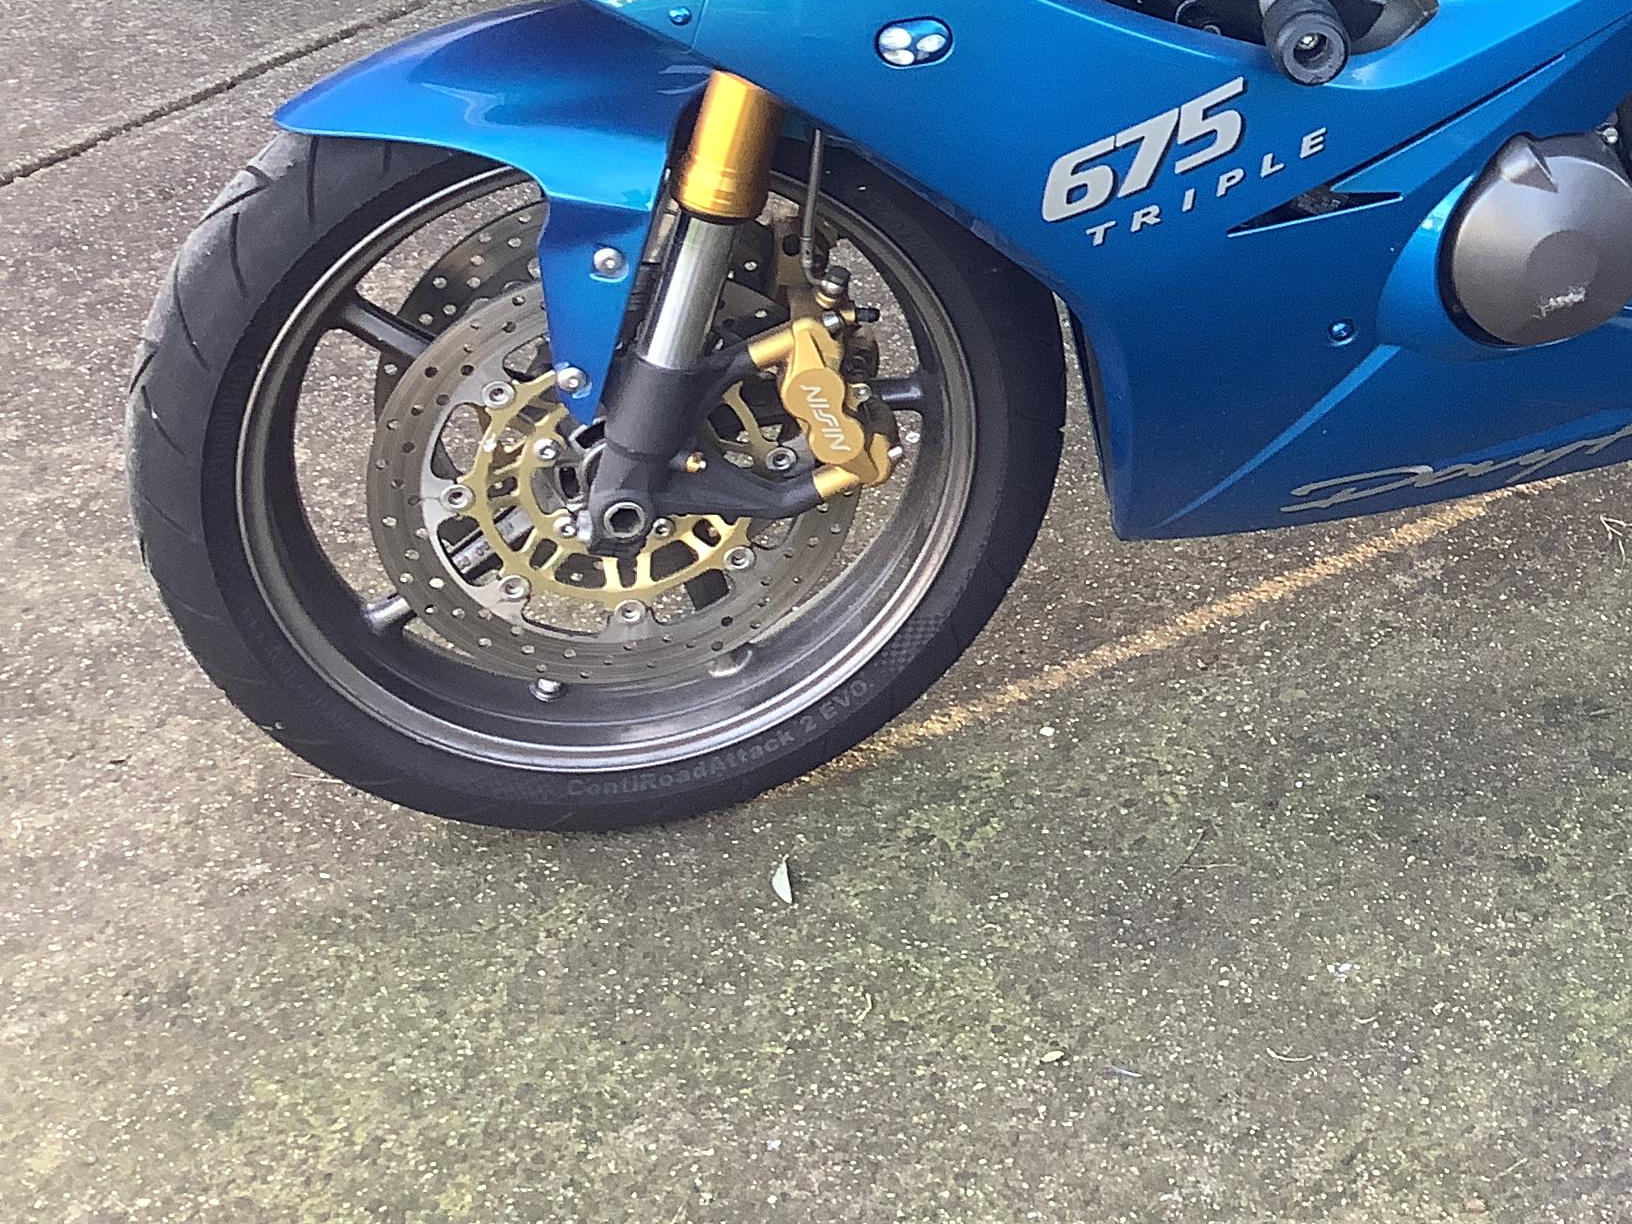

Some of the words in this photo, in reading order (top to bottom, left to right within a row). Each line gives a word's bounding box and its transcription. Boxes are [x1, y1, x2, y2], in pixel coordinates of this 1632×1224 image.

[1041, 75, 1247, 223] 675
[1085, 127, 1327, 246] TRIPLE
[802, 384, 851, 452] NISSIN
[799, 713, 817, 733] 2
